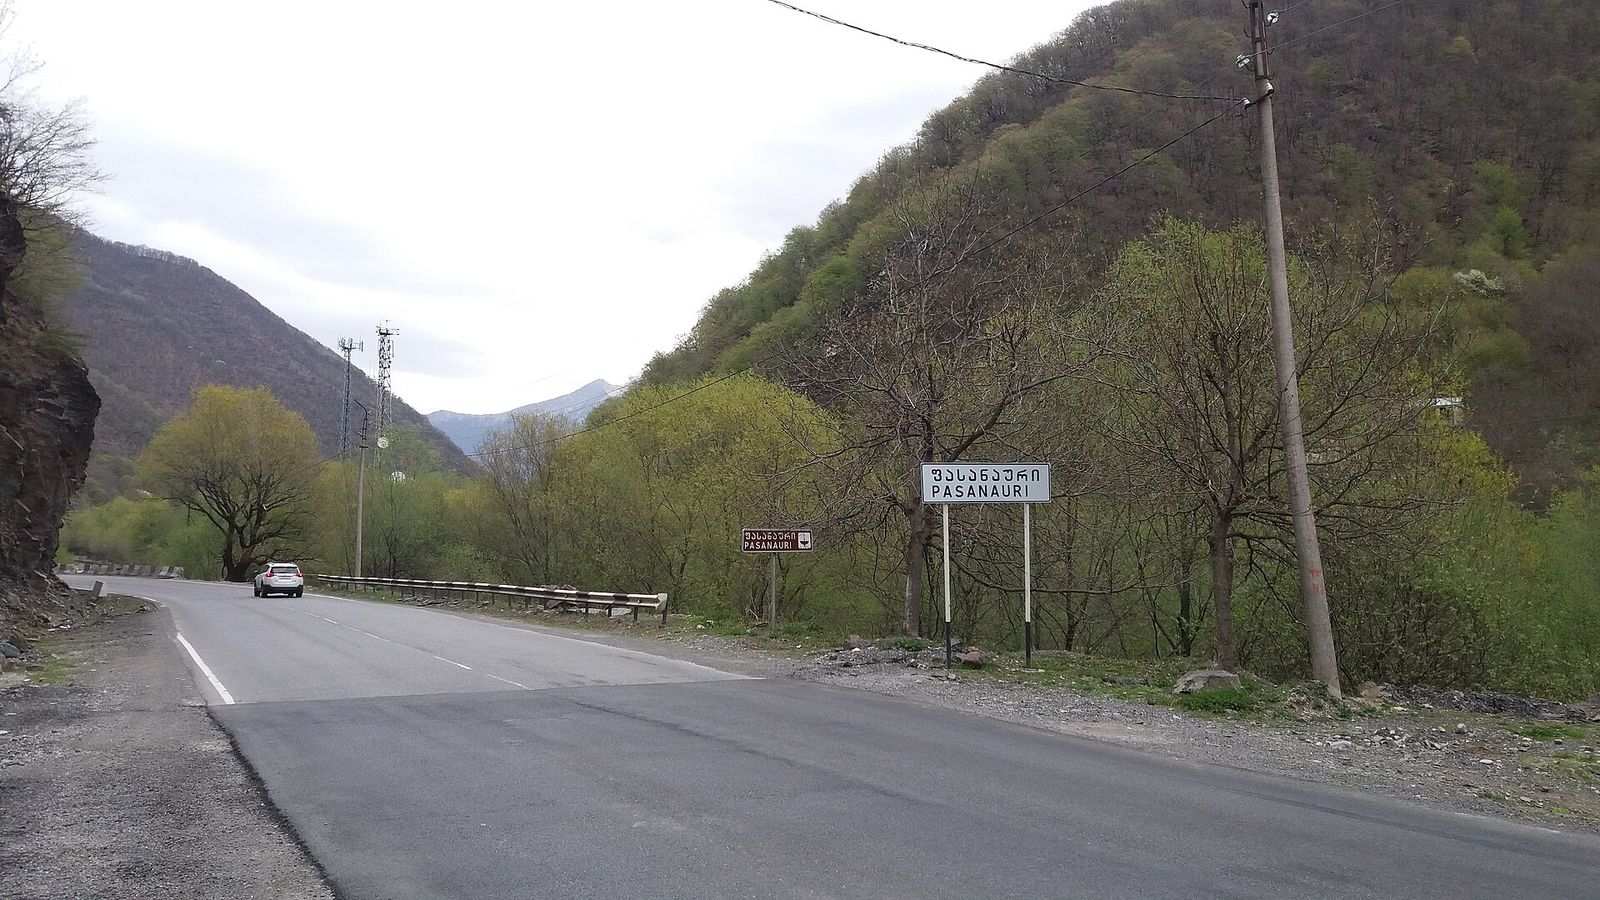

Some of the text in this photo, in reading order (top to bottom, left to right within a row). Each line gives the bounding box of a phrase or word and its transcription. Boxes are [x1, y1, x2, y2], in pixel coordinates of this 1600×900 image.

[931, 468, 1040, 482] ფასანაური
[932, 484, 1029, 498] PASANAURI
[744, 531, 796, 540] ფასანაური
[744, 541, 792, 550] PASANAURI
